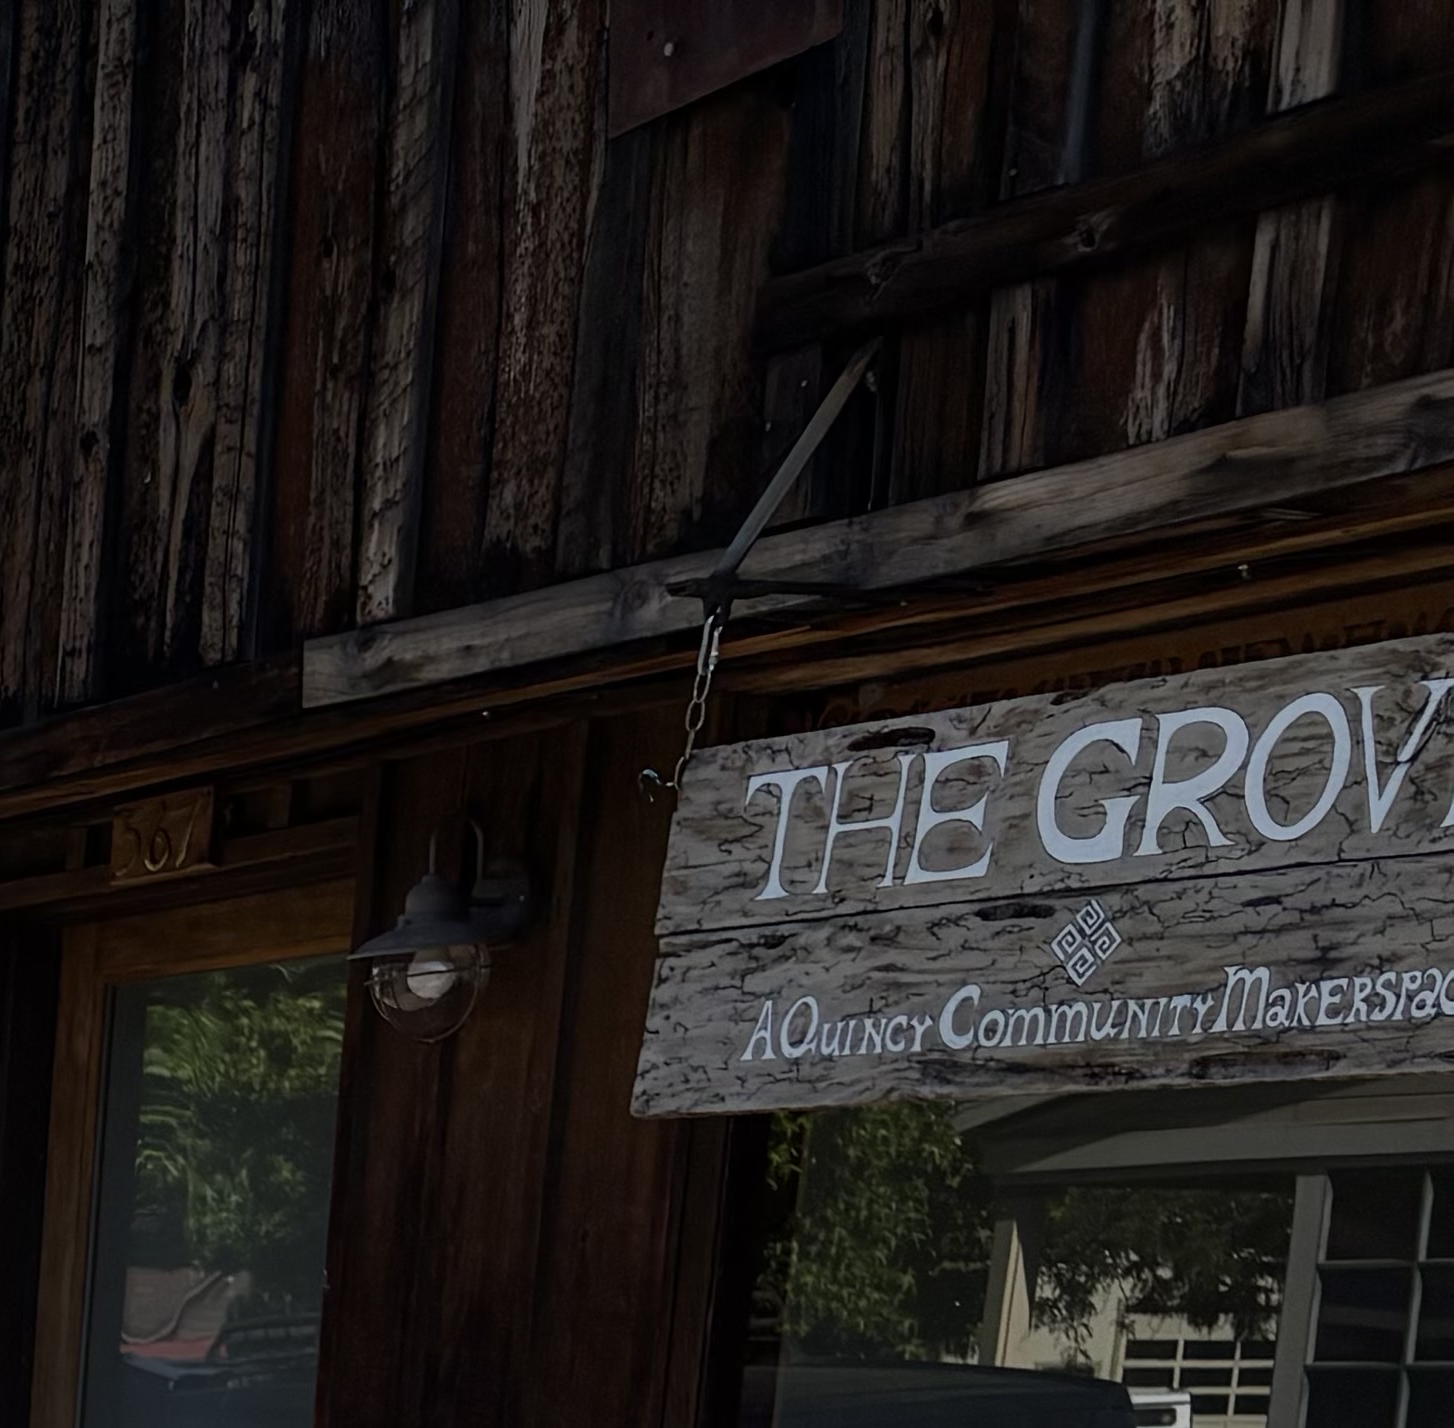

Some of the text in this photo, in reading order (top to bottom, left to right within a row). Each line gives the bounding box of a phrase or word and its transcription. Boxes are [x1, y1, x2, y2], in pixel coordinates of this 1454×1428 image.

[745, 739, 1009, 901] THE
[1036, 677, 1454, 864] GROV
[739, 999, 777, 1062] A
